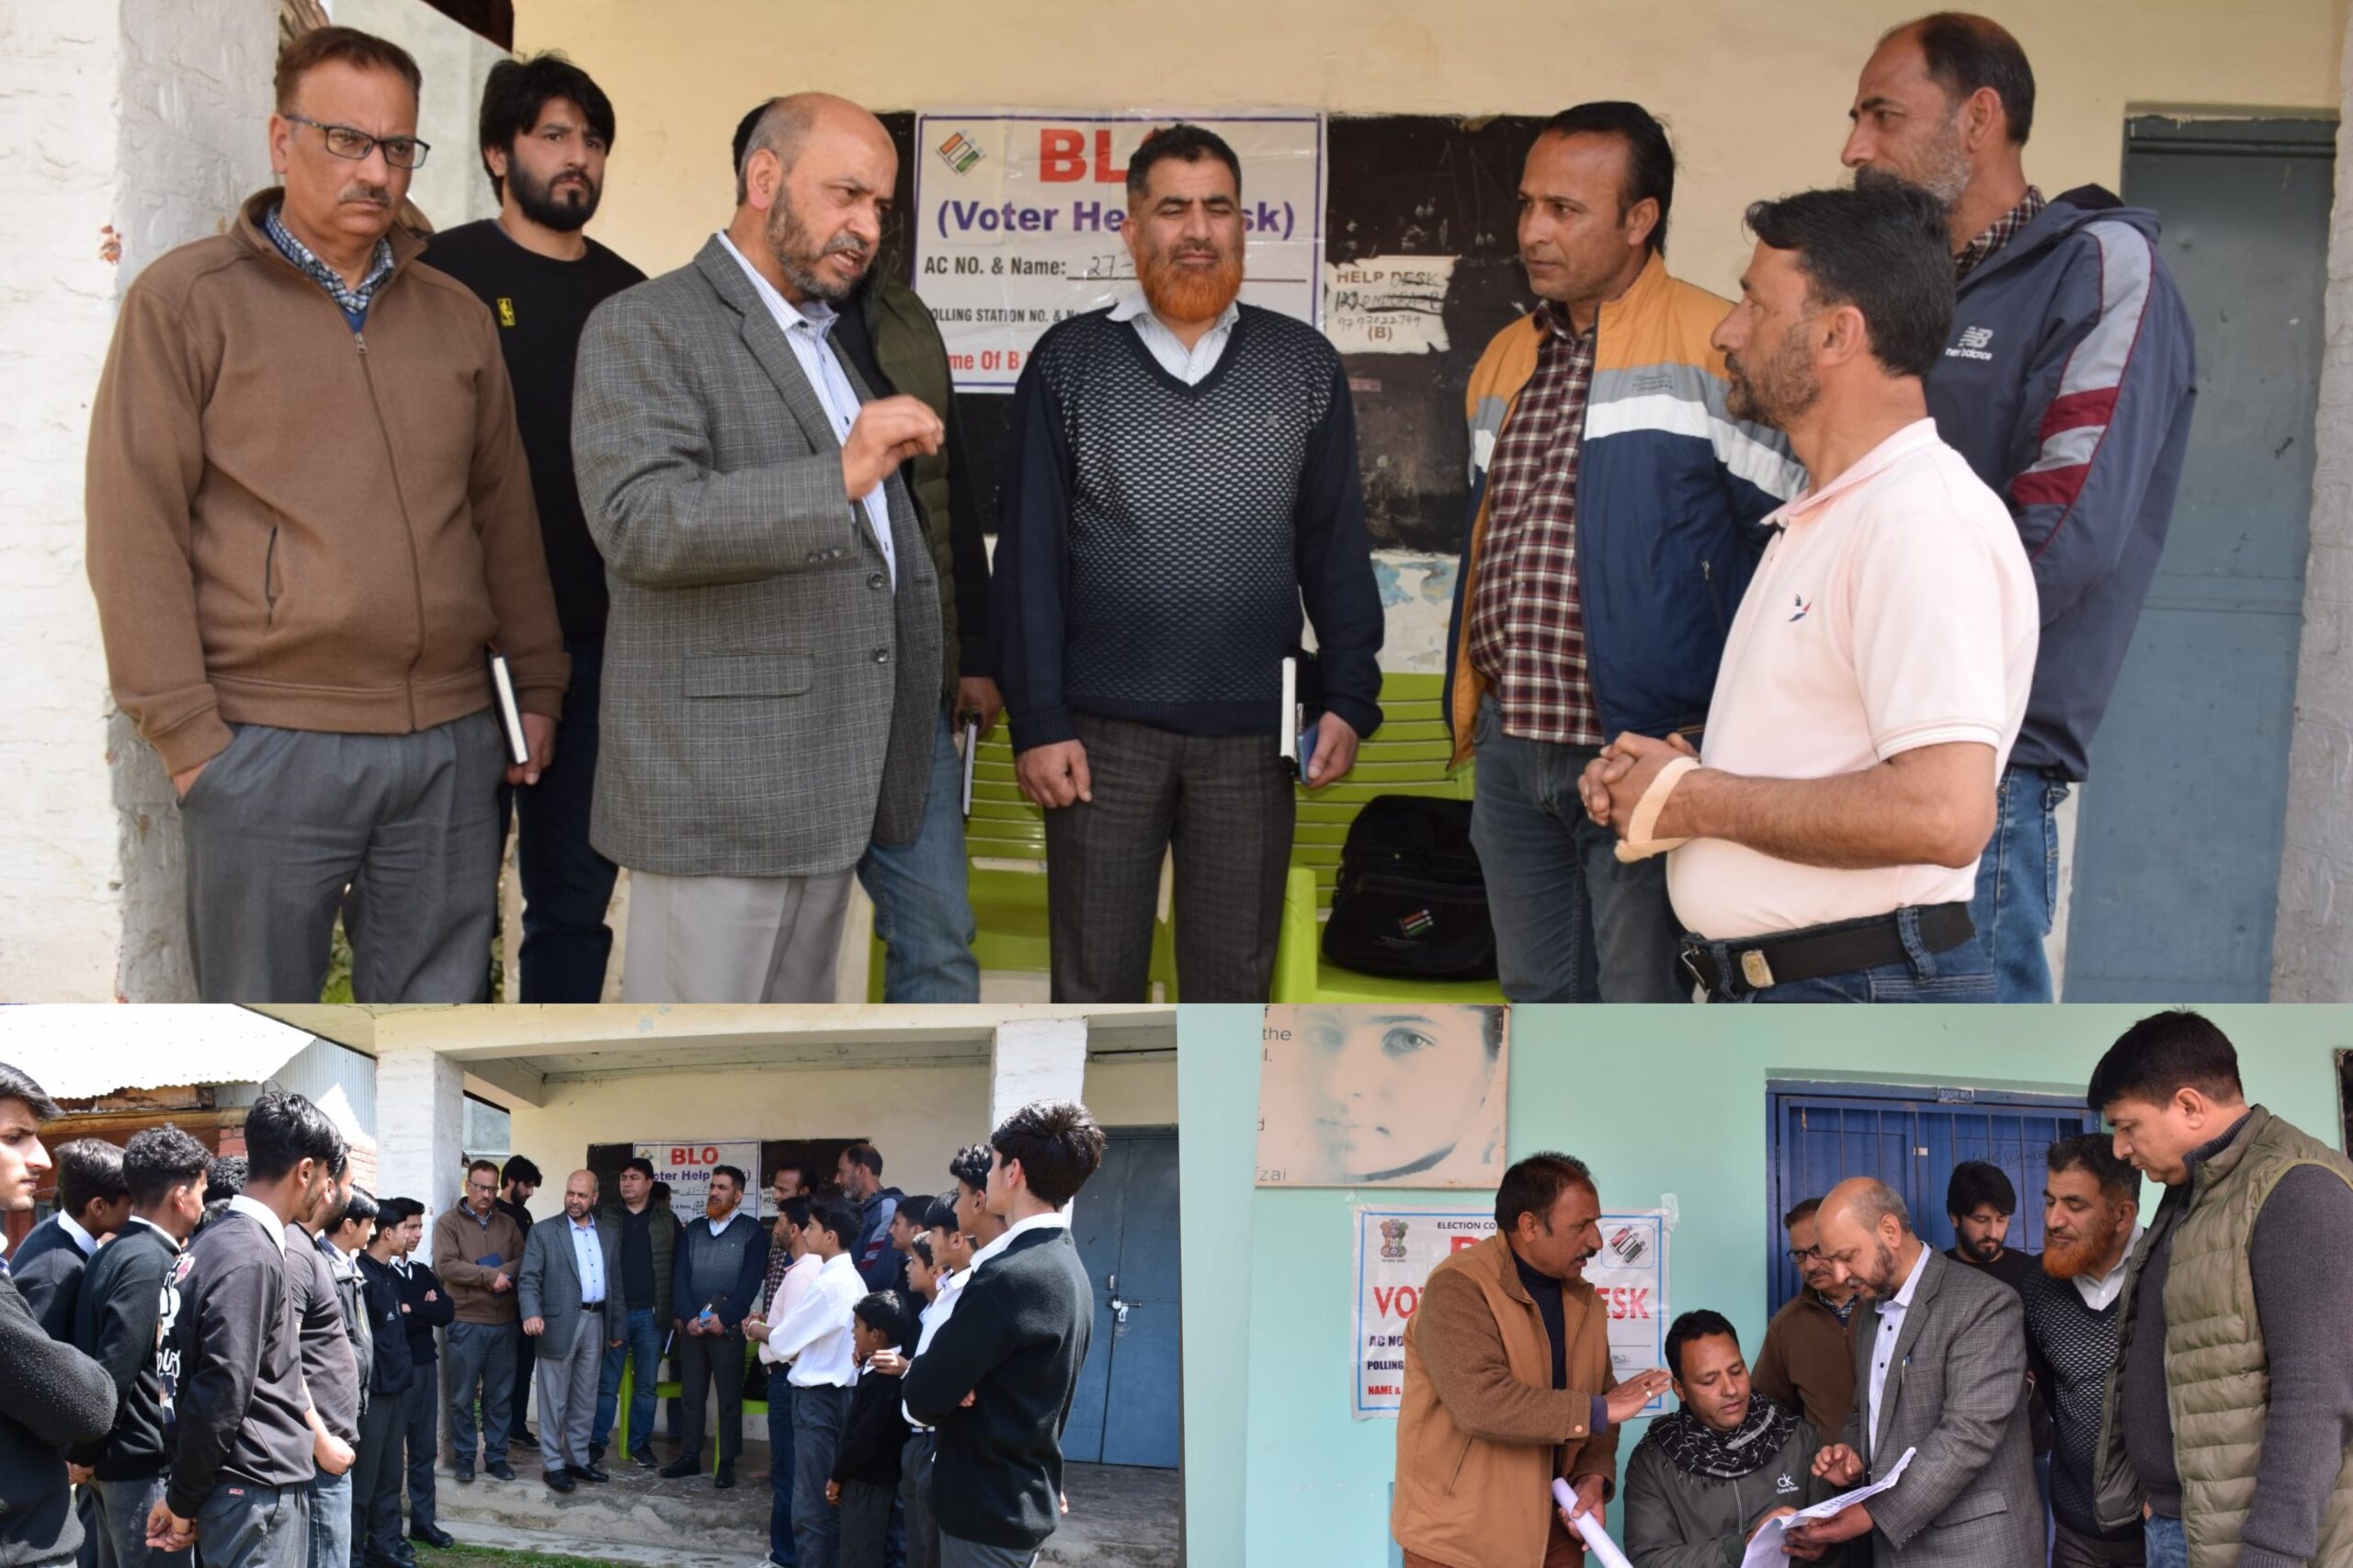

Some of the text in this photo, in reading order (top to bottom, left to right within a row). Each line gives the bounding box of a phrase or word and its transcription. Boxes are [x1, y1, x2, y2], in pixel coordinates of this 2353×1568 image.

[1040, 128, 1153, 183] BL
[938, 200, 1294, 241] (Voter He sk)
[925, 256, 1066, 275] AC NO. & Name:
[1336, 271, 1383, 283] HELP
[931, 308, 972, 322] OLLING
[976, 309, 1025, 322] STATION
[1029, 310, 1049, 323] NO.
[1368, 326, 1392, 341] (B)
[947, 352, 974, 369] me
[981, 350, 1001, 370] Of
[1262, 1028, 1291, 1040] the
[670, 1147, 719, 1165] BLO
[653, 1170, 710, 1182] oter Help
[1256, 1167, 1287, 1182] zai
[1438, 1221, 1481, 1230] ELECTION
[1374, 1285, 1651, 1320] VO ESK
[1369, 1335, 1386, 1347] AC
[1367, 1360, 1404, 1370] POLLING
[1368, 1385, 1392, 1395] NAME
